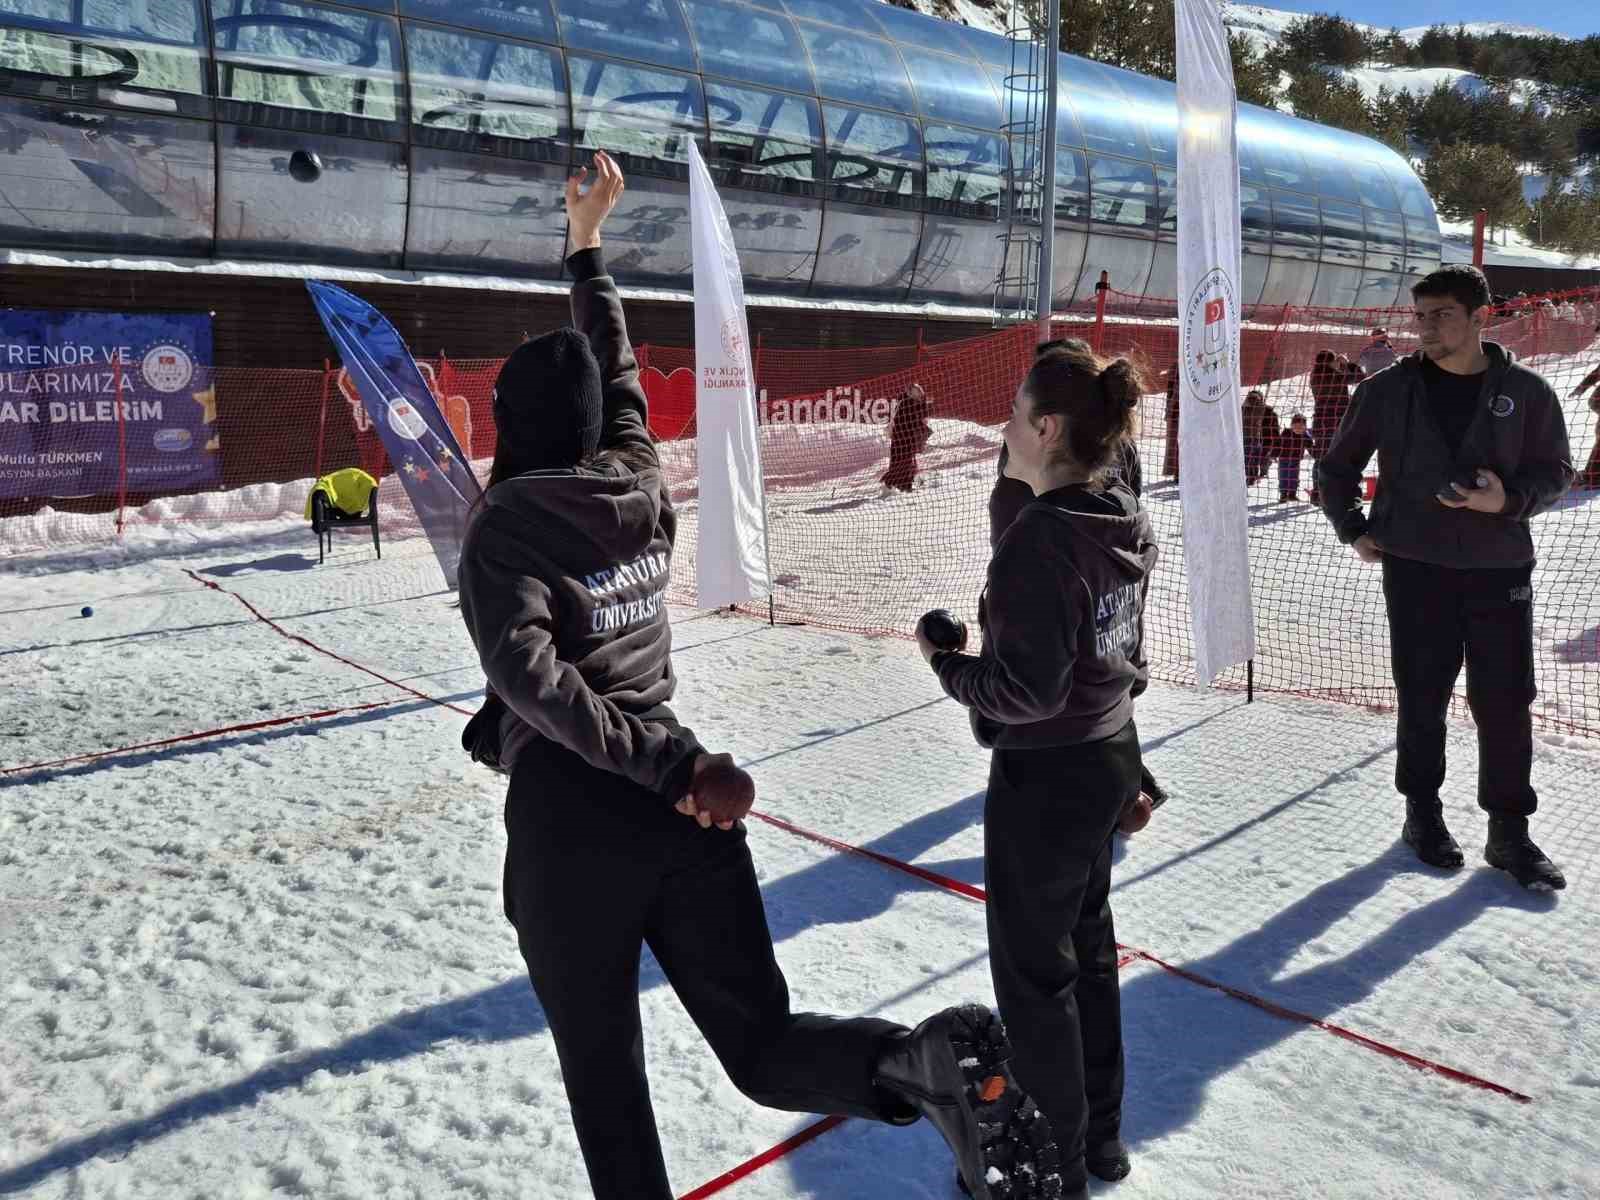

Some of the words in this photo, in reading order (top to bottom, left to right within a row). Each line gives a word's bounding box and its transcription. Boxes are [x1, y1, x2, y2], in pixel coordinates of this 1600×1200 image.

[101, 345, 132, 365] VE
[0, 400, 40, 423] AR
[39, 451, 103, 464] TÜRKMEN
[584, 552, 668, 597] ATATÜRK
